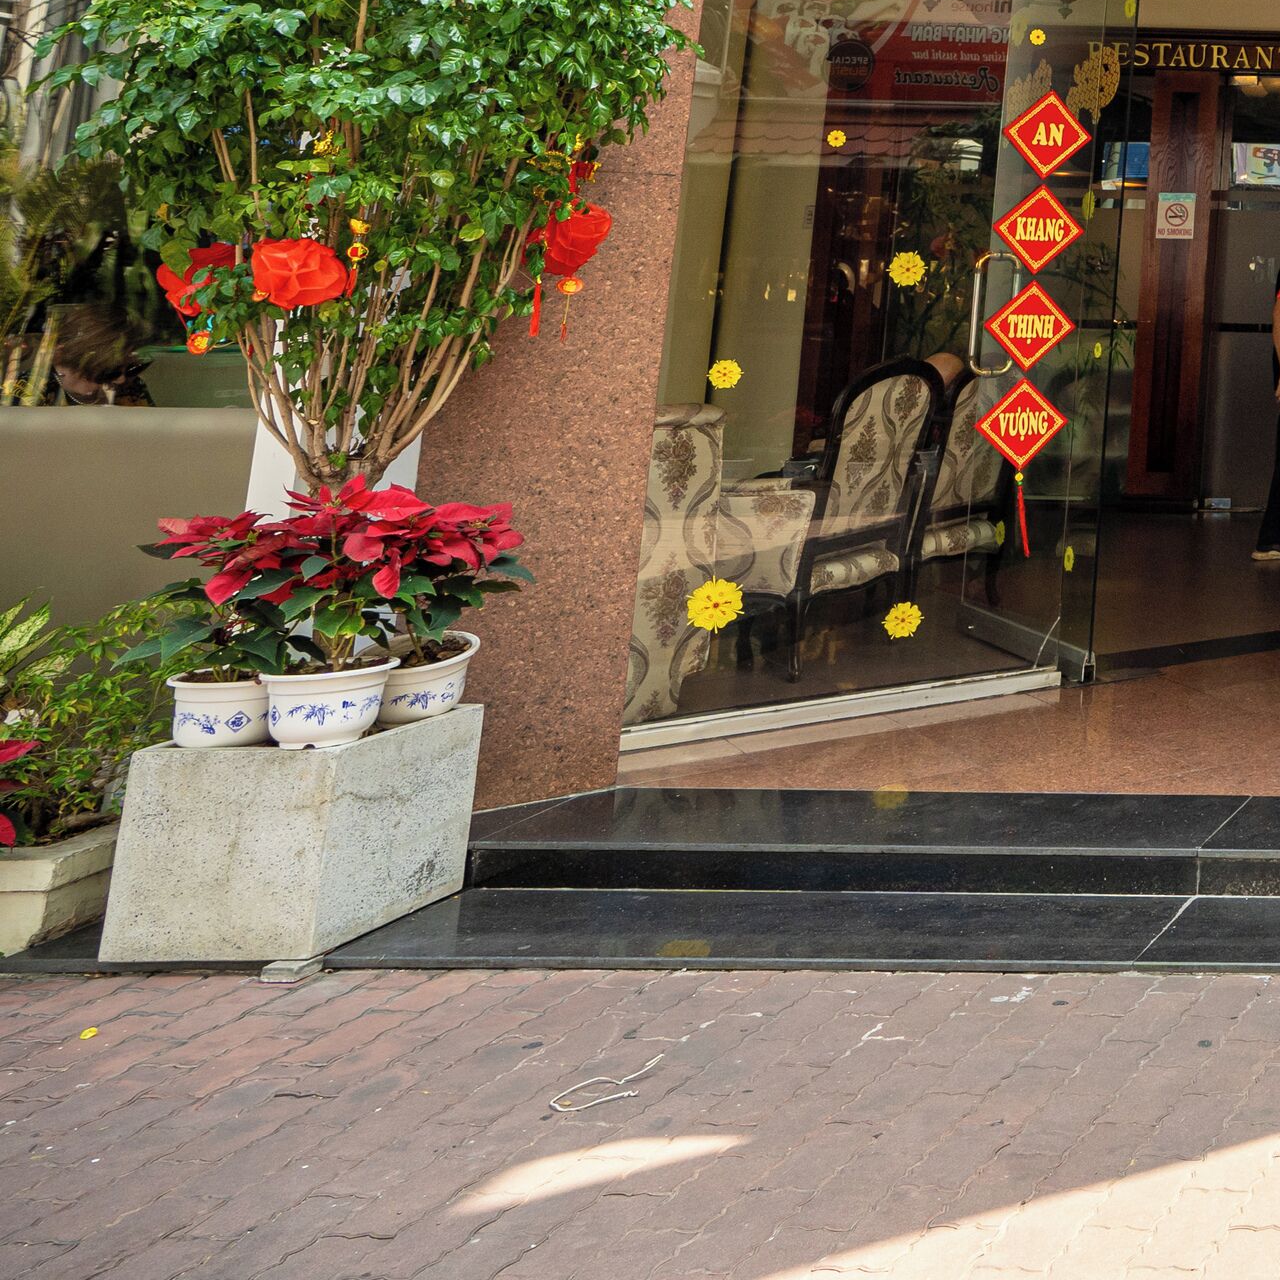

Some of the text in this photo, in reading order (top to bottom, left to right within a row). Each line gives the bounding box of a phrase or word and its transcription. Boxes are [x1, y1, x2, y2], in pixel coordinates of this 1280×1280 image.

[1032, 122, 1065, 147] AN
[1015, 217, 1065, 242] KHANG
[1007, 314, 1056, 345] THỊNH
[999, 406, 1049, 442] VƯỢNG
